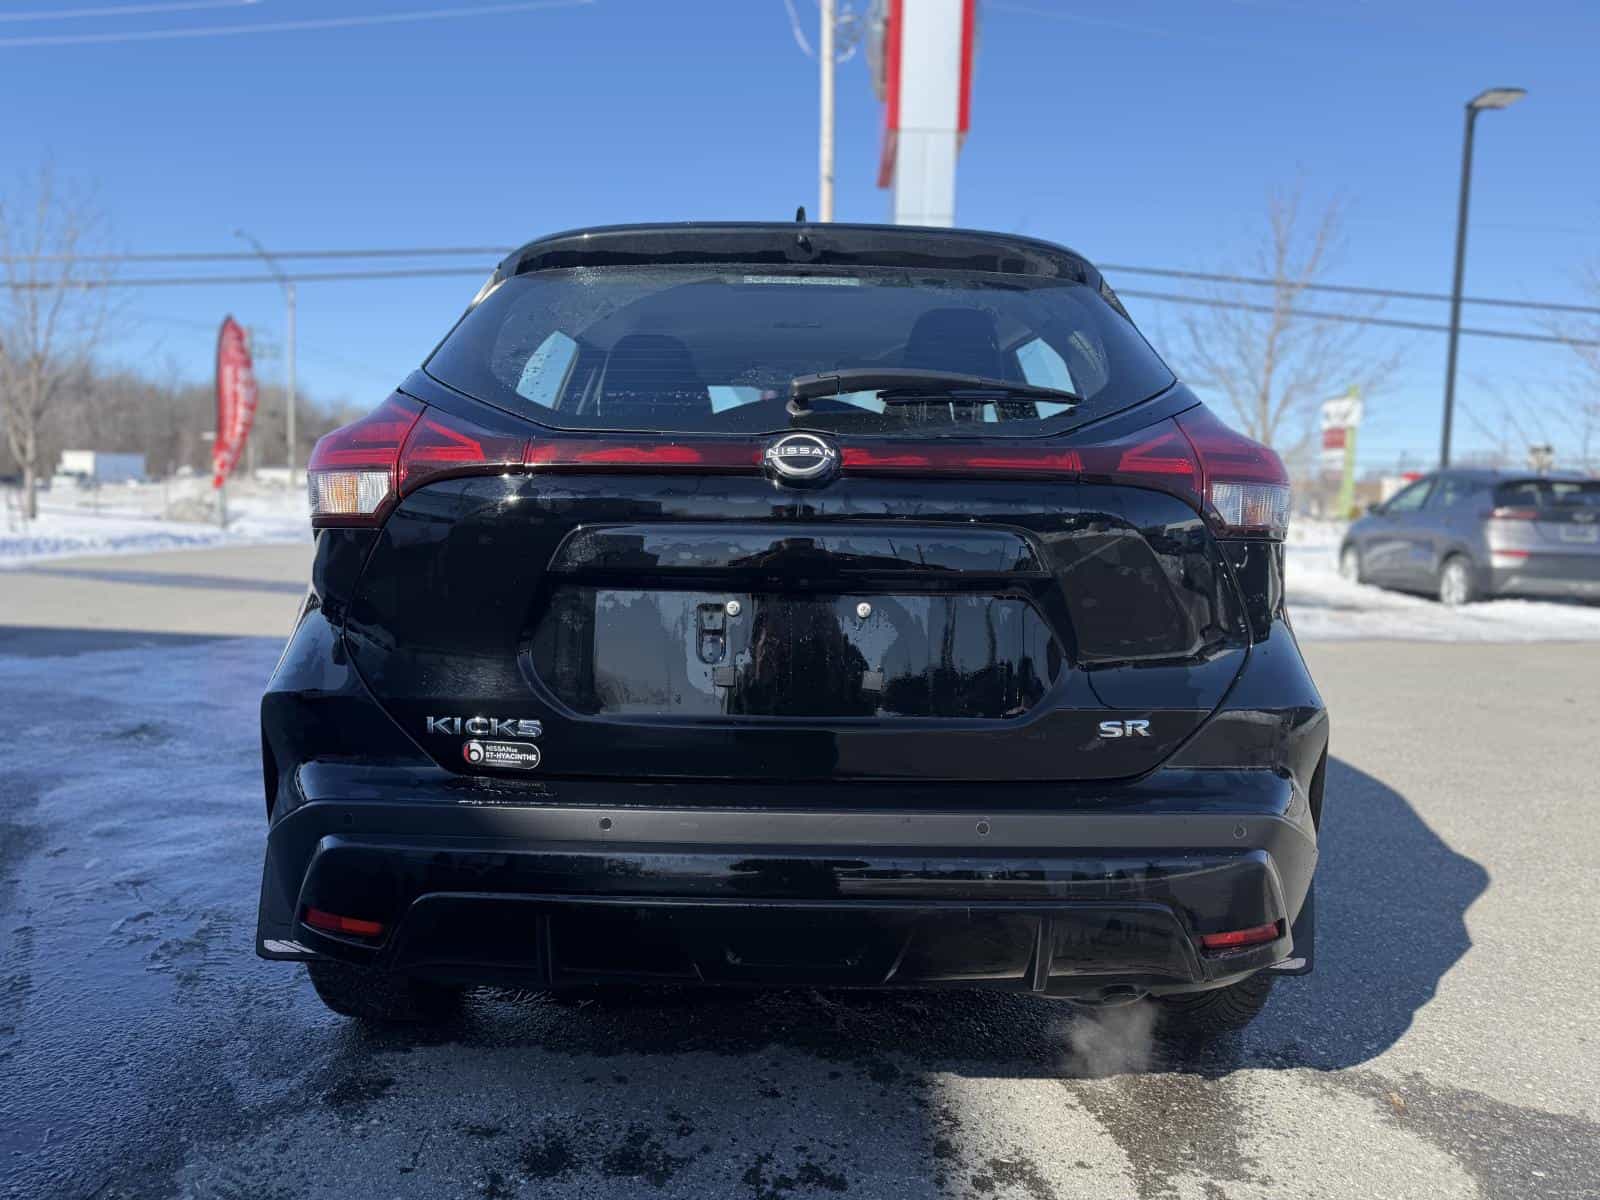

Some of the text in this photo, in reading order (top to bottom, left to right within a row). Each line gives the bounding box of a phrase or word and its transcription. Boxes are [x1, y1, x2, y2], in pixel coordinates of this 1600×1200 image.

[767, 447, 835, 457] NISSAN
[426, 715, 543, 738] KICKS
[1099, 720, 1150, 737] SR
[486, 743, 512, 752] NISSAN
[486, 751, 537, 761] ST-HYACINTHE
